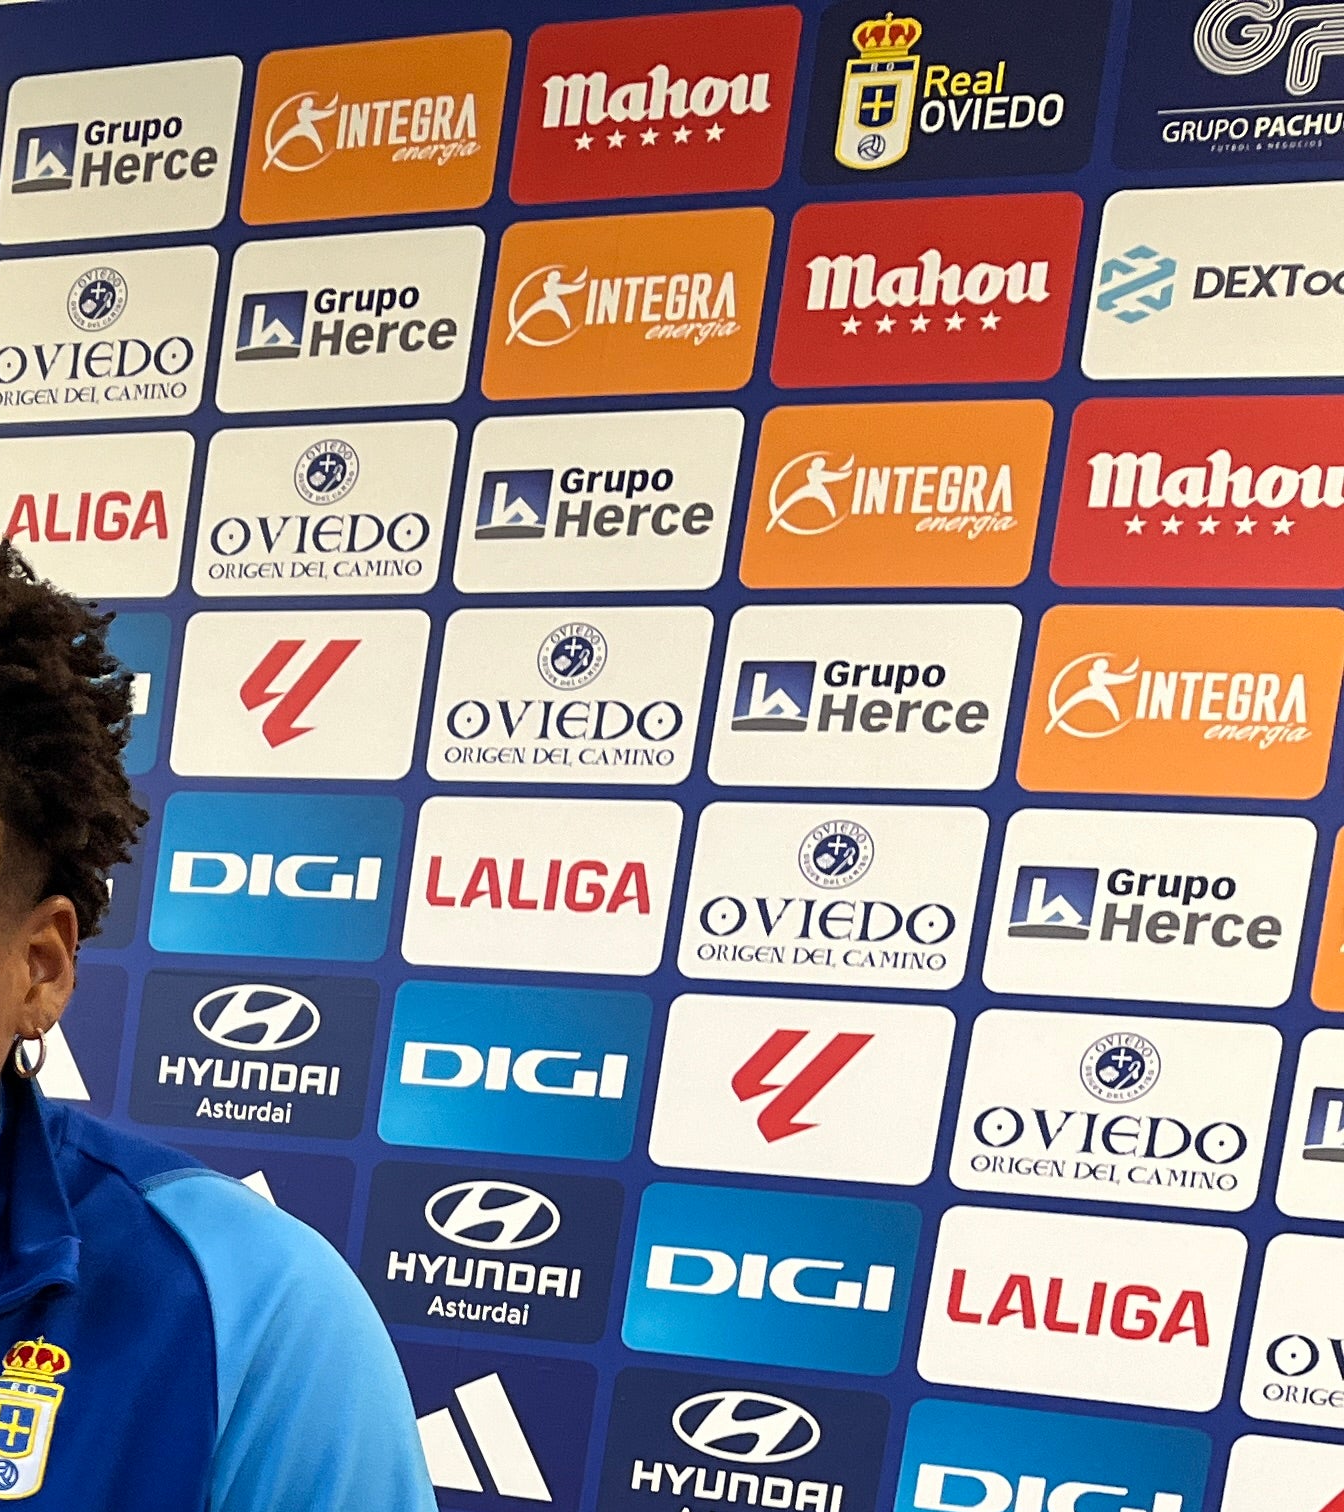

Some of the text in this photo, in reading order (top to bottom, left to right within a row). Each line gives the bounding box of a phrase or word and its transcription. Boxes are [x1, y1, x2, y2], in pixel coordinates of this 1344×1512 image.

[542, 64, 771, 128] Mahou
[924, 61, 1005, 98] Real
[84, 115, 182, 149] Grupo
[335, 93, 477, 150] INTEGRA
[919, 93, 1064, 134] OVIEDO
[1162, 113, 1344, 143] GRUPO PACHU
[80, 144, 218, 189] Herce
[584, 272, 736, 325] INTEGRA
[806, 248, 1050, 311] Mahou
[314, 286, 419, 317] Grupo
[310, 318, 457, 357] Herce
[64, 385, 100, 405] DEL
[104, 381, 187, 403] CAMINO
[560, 467, 674, 500] Grupo
[851, 463, 1013, 516] INTEGRA
[1087, 448, 1344, 510] Mahou
[211, 513, 430, 556] OVIEDO
[554, 500, 714, 538] Herce
[208, 559, 422, 580] ORIGEN DEL CAMINO
[823, 660, 946, 691] Grupo
[817, 693, 990, 734] Herce
[1135, 670, 1308, 724] INTEGRA
[446, 700, 683, 741] OVIEDO
[444, 746, 675, 767] ORIGEN DEL CAMINO
[169, 851, 383, 900] DIGI
[425, 855, 651, 915] LALIGA
[1106, 868, 1236, 905] Grupo
[700, 896, 956, 945] OVIEDO
[1100, 902, 1283, 950] Herce
[697, 943, 947, 971] ORIGEN DEL CAMINO
[157, 1055, 341, 1097] HYUNDAI
[400, 1041, 629, 1099] DIGI
[196, 1097, 292, 1125] Asturdai
[973, 1106, 1248, 1164] OVIEDO
[970, 1154, 1238, 1193] ORIGEN DEL CAMINO
[386, 1251, 582, 1299] HYUNDAI
[645, 1245, 896, 1312] DIGI
[427, 1295, 529, 1326] Asturdai
[946, 1268, 1210, 1347] LALIGA
[1263, 1383, 1344, 1408] ORIGE
